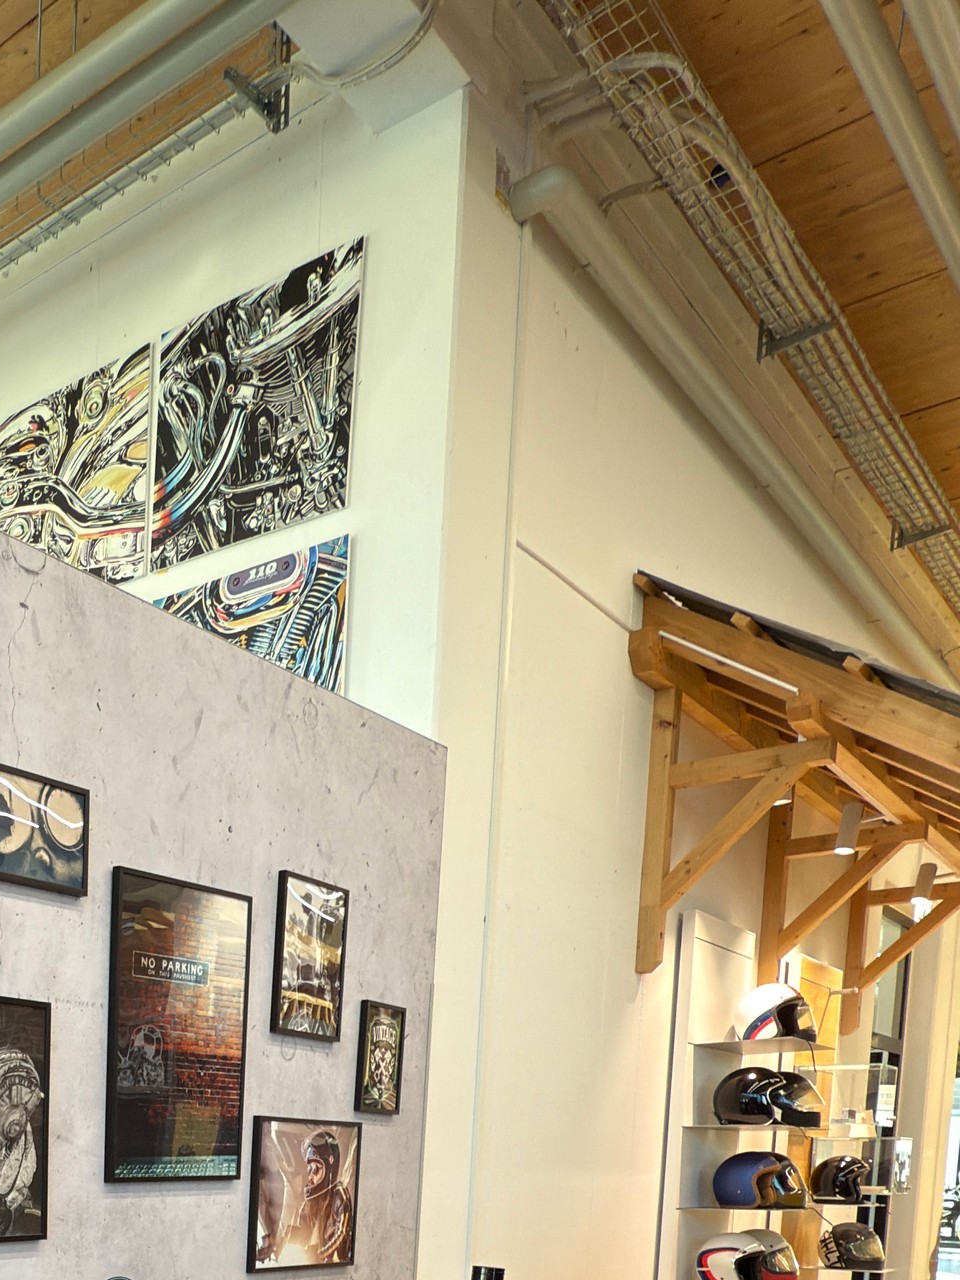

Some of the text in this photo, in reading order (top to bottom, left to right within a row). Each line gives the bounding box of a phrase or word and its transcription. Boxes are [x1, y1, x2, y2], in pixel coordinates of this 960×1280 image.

[248, 561, 278, 580] 110
[141, 956, 203, 976] NO PARKING
[373, 1025, 397, 1048] VINTAGE
